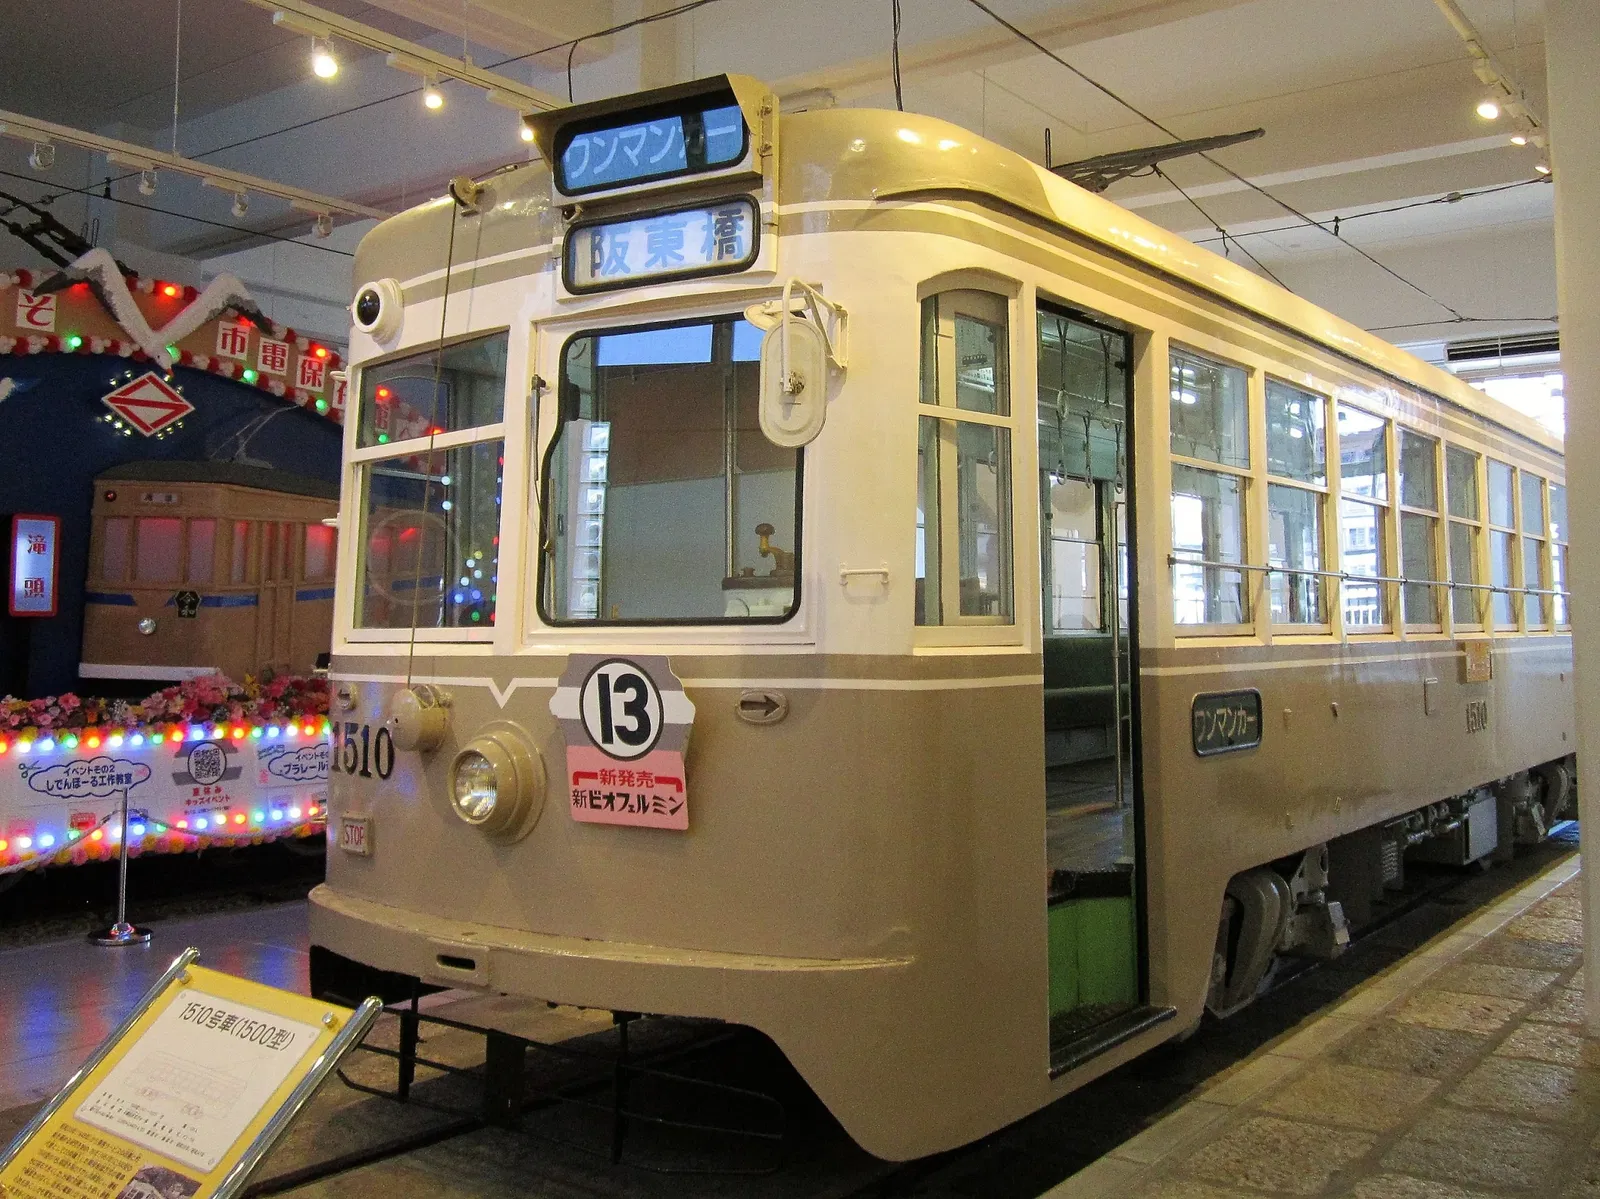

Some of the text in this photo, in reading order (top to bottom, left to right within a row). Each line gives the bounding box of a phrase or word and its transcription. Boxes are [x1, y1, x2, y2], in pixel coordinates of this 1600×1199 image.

[564, 124, 737, 180] ワンマンー
[590, 208, 746, 279] 阪東橋
[23, 534, 47, 599] 滝頭
[596, 672, 651, 747] 13
[1195, 709, 1255, 744] ワンマンカー
[63, 764, 116, 776] イベントその2
[331, 721, 395, 780] 1510
[571, 789, 685, 817] 新ビオフェルミン
[599, 768, 655, 789] 新発売
[344, 824, 365, 846] STOP
[178, 1001, 296, 1052] 1510号車(1500型)
